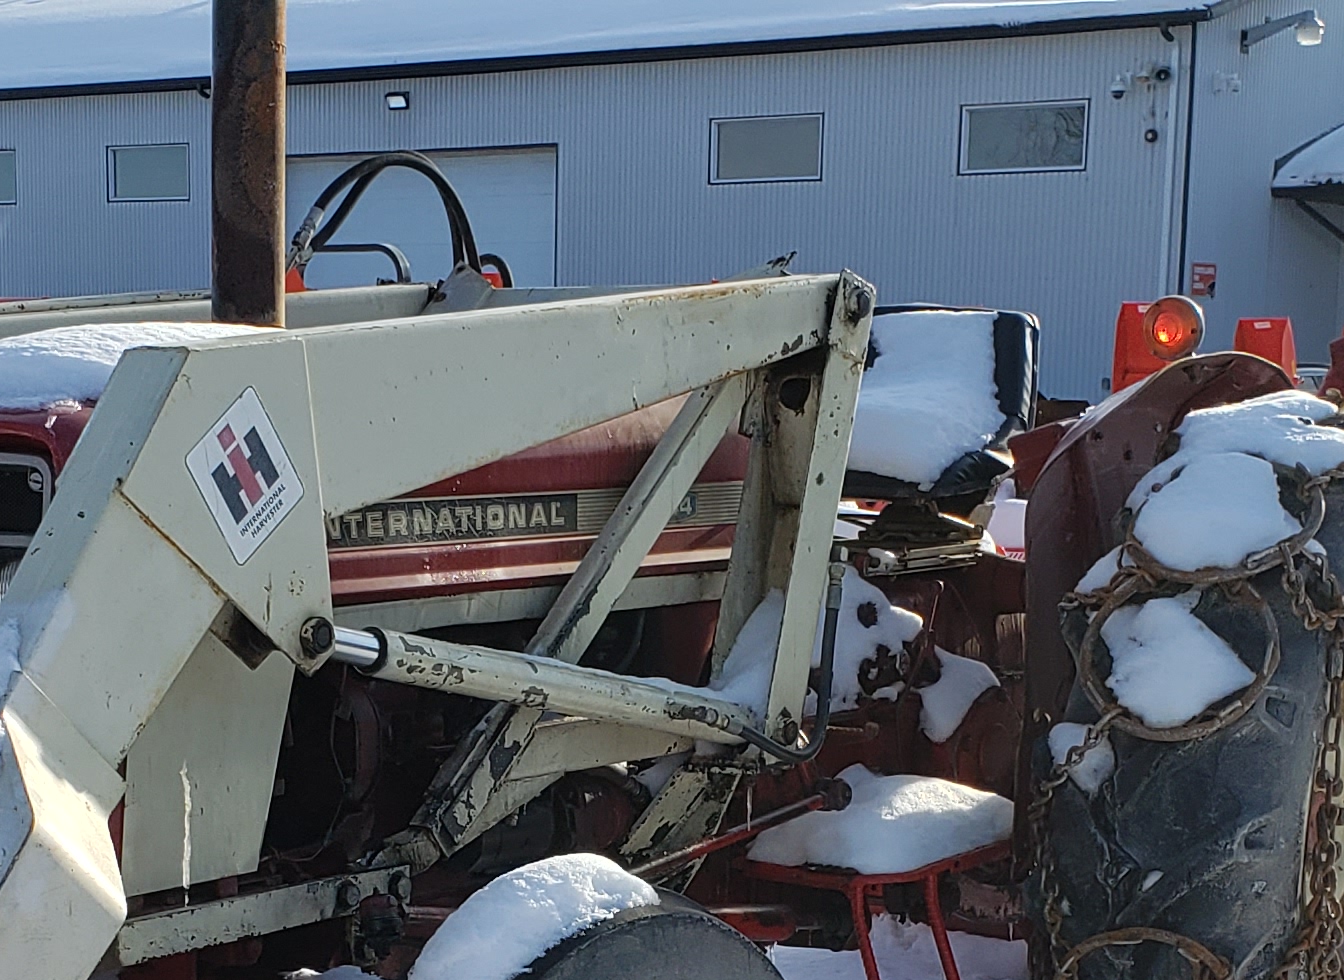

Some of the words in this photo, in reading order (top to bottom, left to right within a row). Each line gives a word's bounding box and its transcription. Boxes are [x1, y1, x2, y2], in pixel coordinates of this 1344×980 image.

[240, 483, 286, 537] INTERNATIONAL
[251, 499, 284, 538] HARVESTER
[325, 502, 565, 540] NTERNATIONAL
